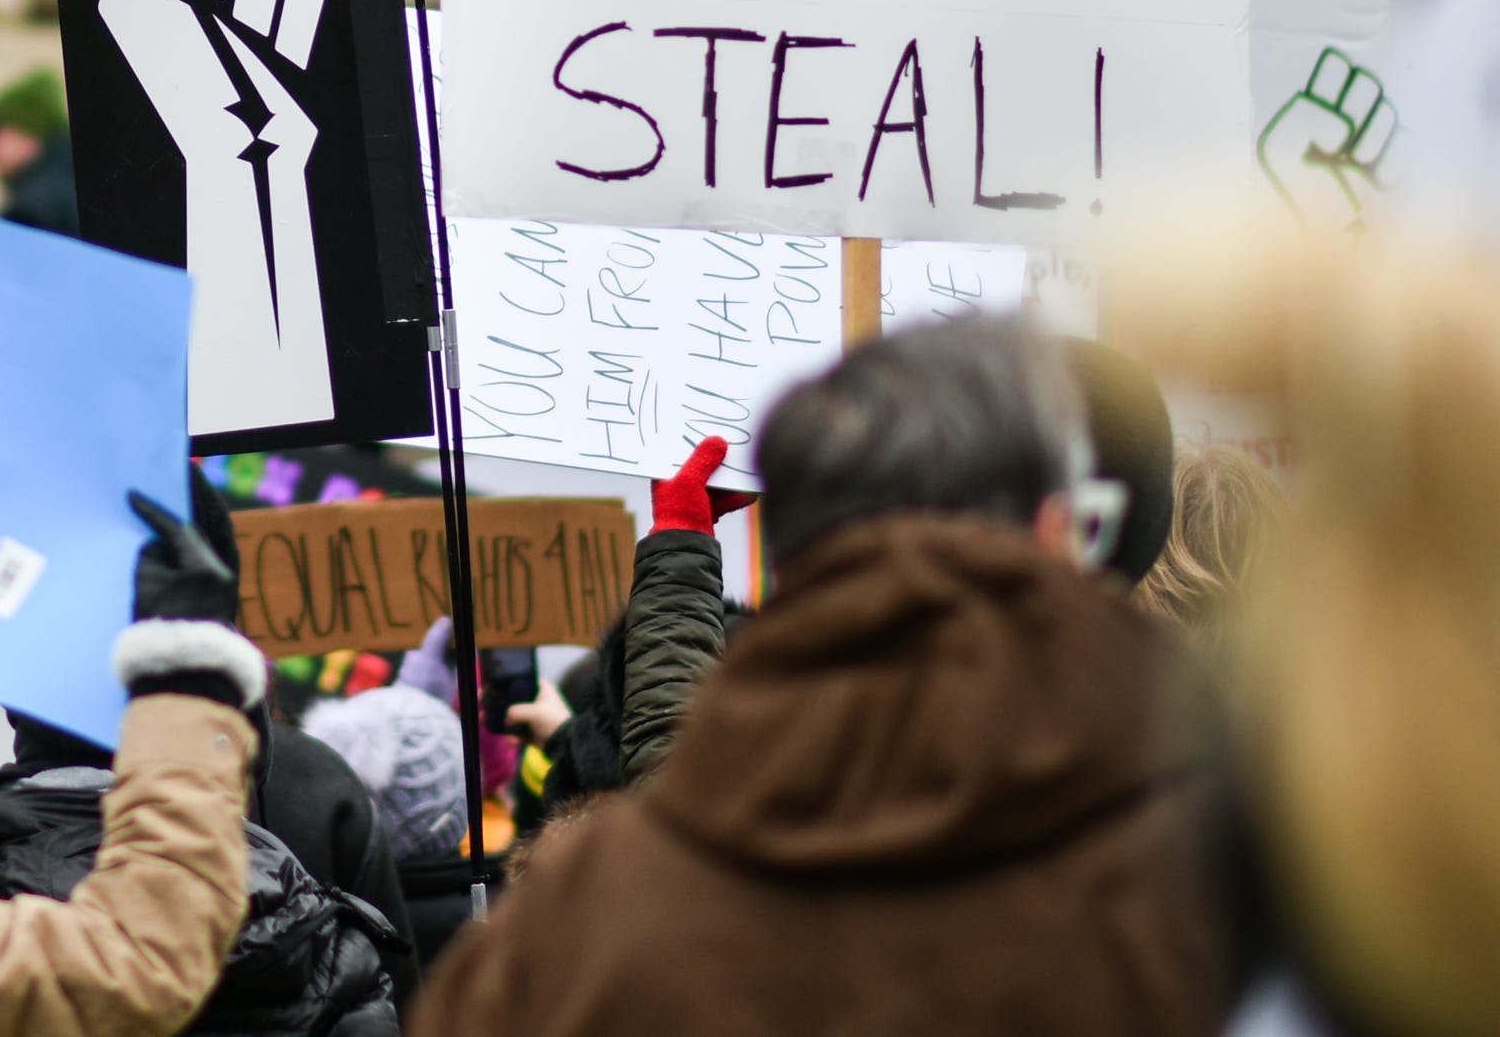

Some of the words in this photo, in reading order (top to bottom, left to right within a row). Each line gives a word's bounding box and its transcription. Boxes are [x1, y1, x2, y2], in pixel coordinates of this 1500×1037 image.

[553, 21, 1107, 217] STEAL!
[587, 228, 661, 331] FRO
[457, 335, 564, 443] YOU
[579, 350, 644, 465] HIM
[237, 525, 413, 642] EQUAL
[542, 519, 577, 638] 4
